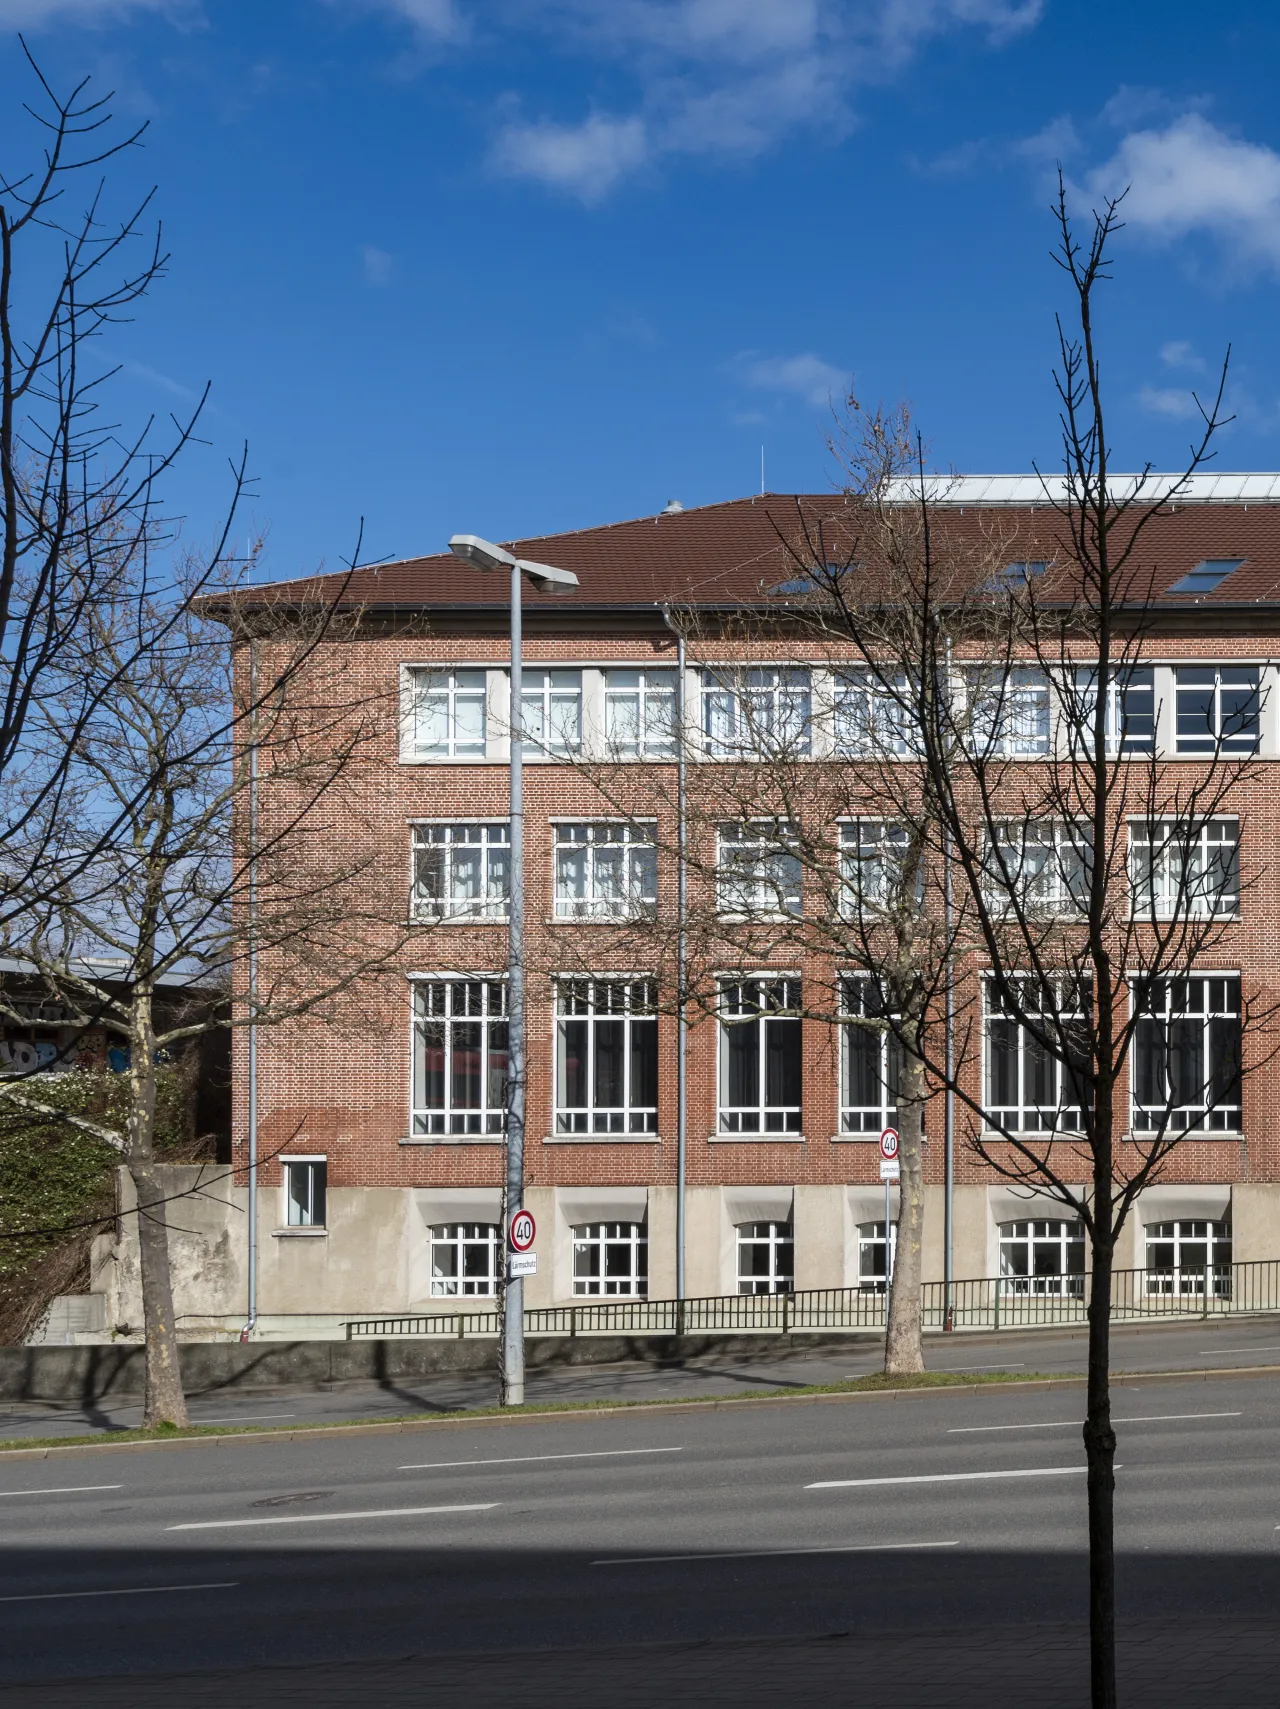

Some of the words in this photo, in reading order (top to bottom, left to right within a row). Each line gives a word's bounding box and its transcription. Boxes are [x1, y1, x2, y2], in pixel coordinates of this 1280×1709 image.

[884, 1137, 896, 1151] 40
[516, 1221, 531, 1240] 40
[512, 1260, 536, 1270] Lärmschutz
